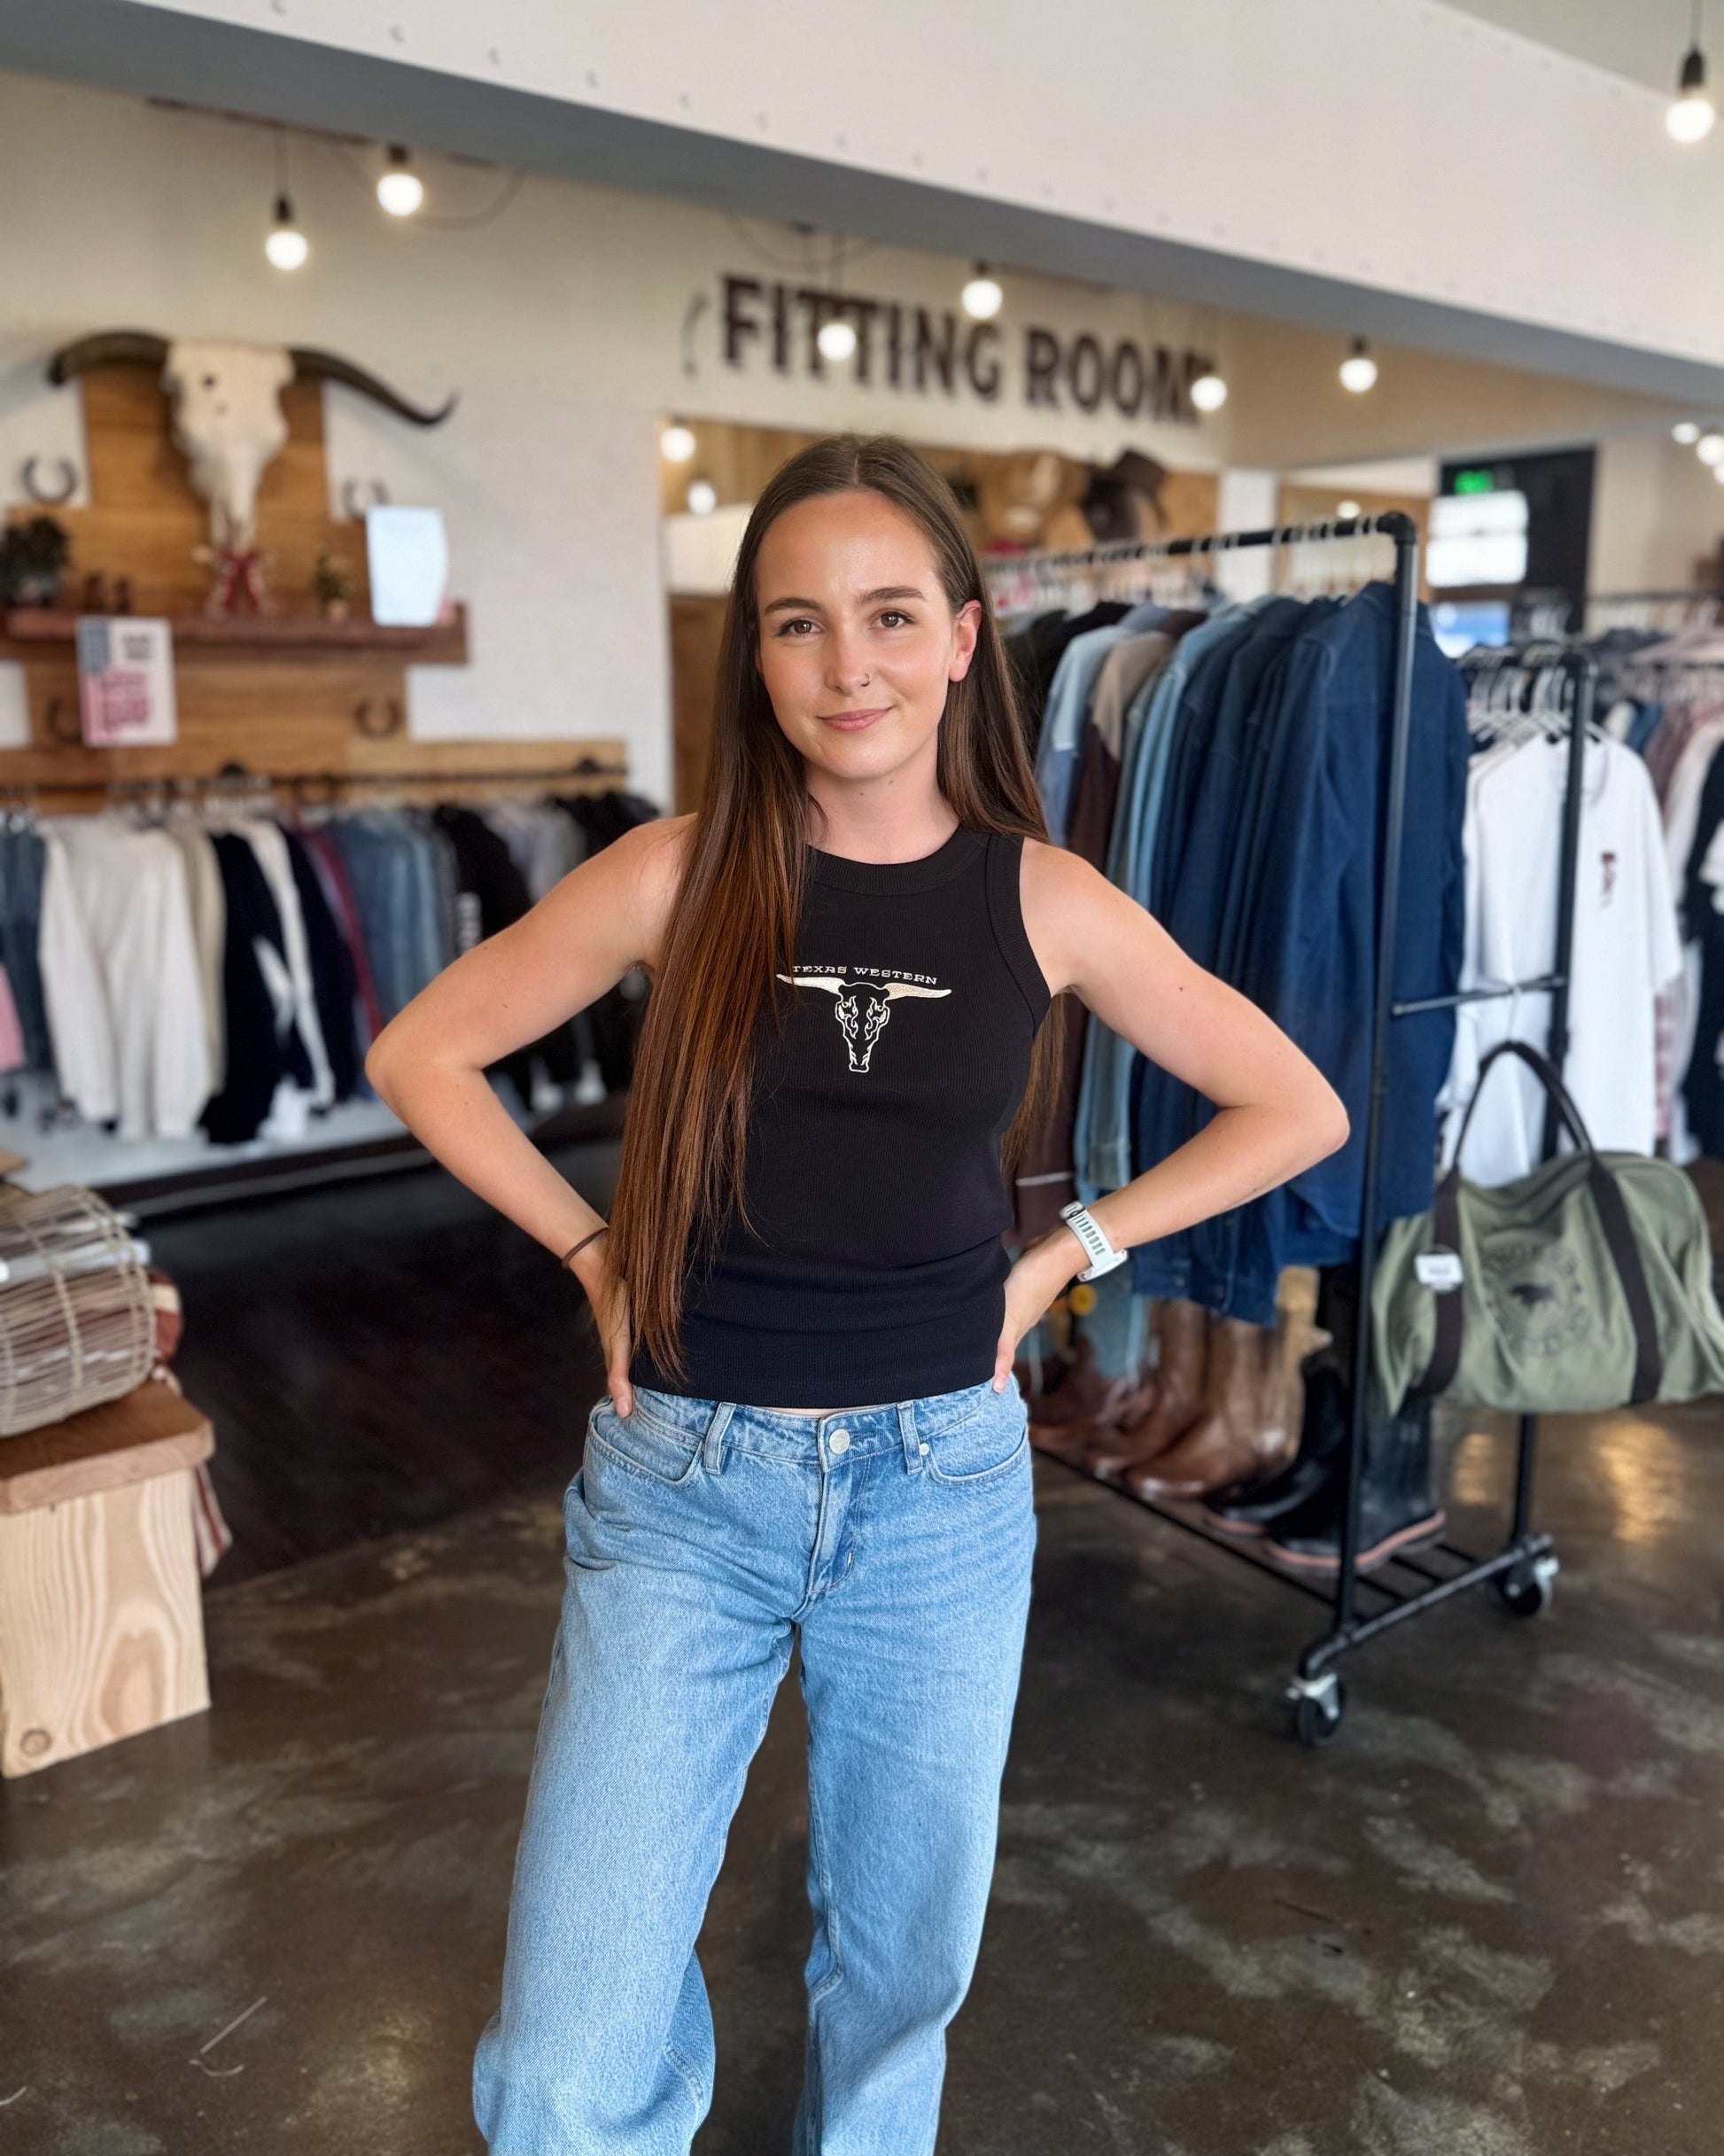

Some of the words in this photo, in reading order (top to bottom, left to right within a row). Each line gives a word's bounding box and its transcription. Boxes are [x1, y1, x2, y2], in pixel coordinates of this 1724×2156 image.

[720, 276, 1000, 401] FITTING
[792, 965, 848, 974] TEXAS
[853, 967, 937, 985] WESTERN
